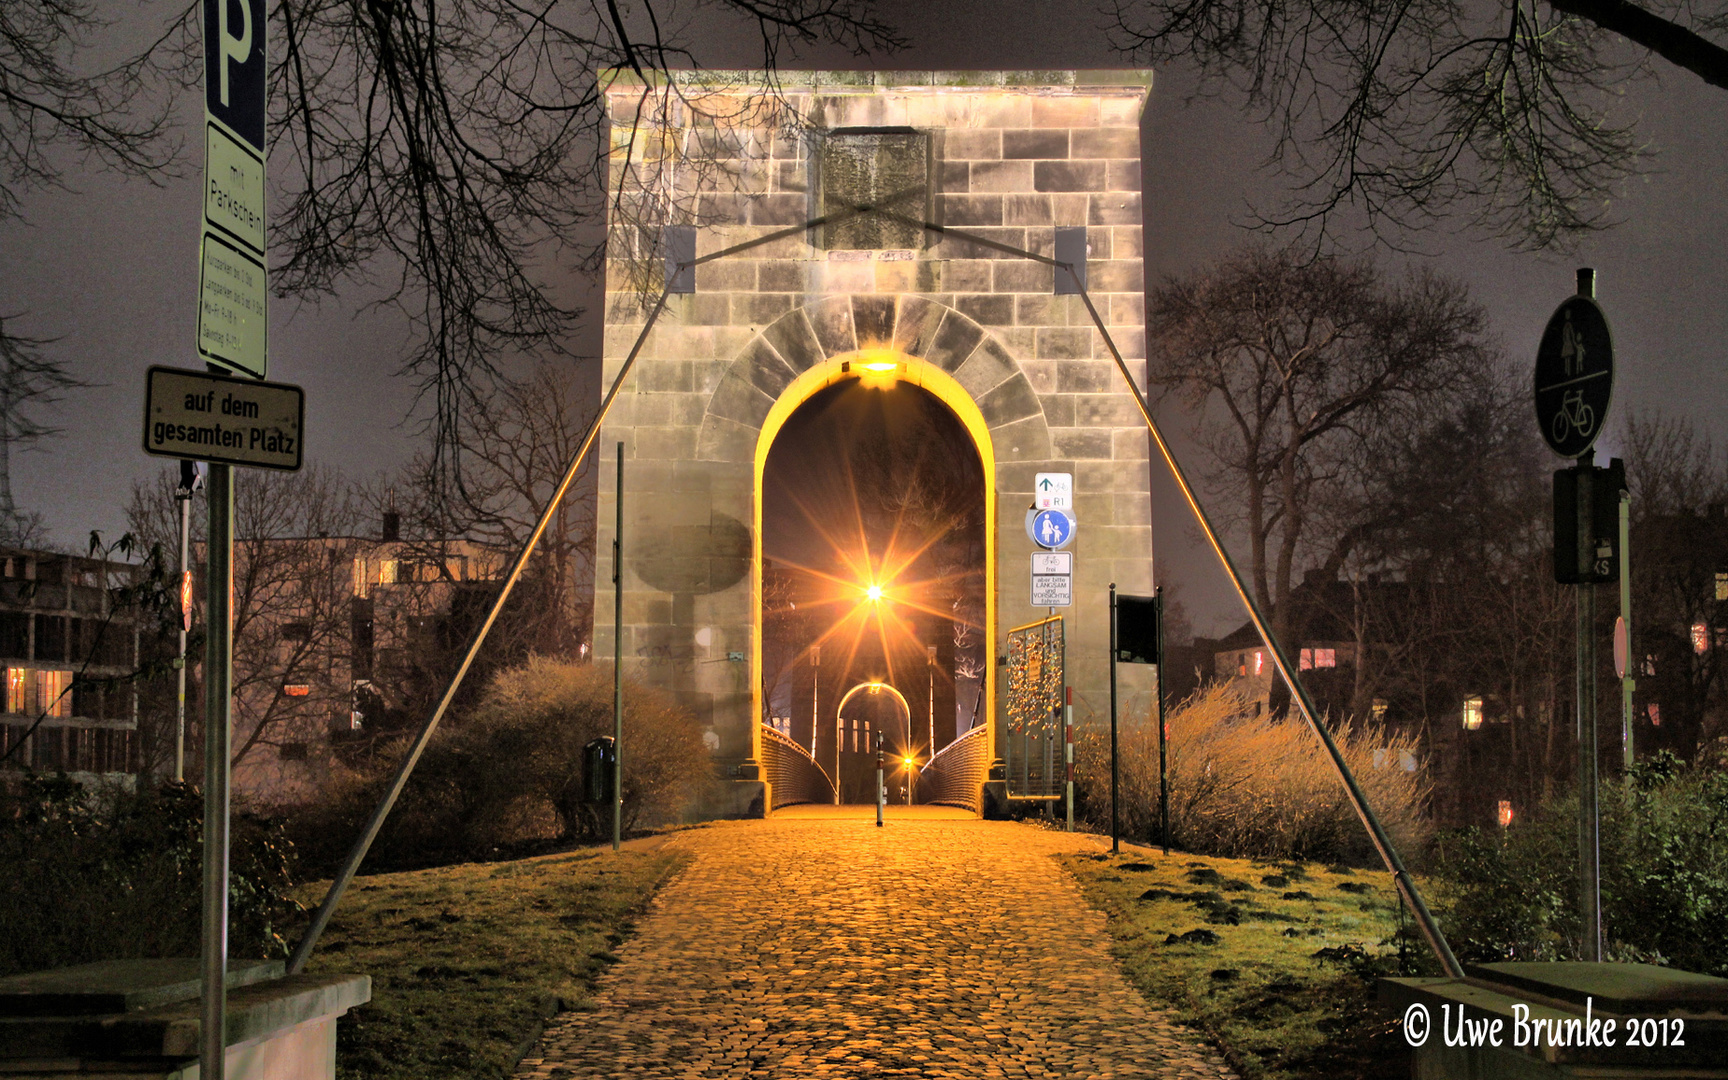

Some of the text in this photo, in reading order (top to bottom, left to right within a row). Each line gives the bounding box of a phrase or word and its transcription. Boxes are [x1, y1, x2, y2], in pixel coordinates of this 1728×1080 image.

[219, 0, 252, 108] P
[211, 179, 261, 234] Parkschein
[185, 391, 258, 418] auf dem
[155, 422, 294, 454] gesamten Platz
[1054, 497, 1064, 506] R1
